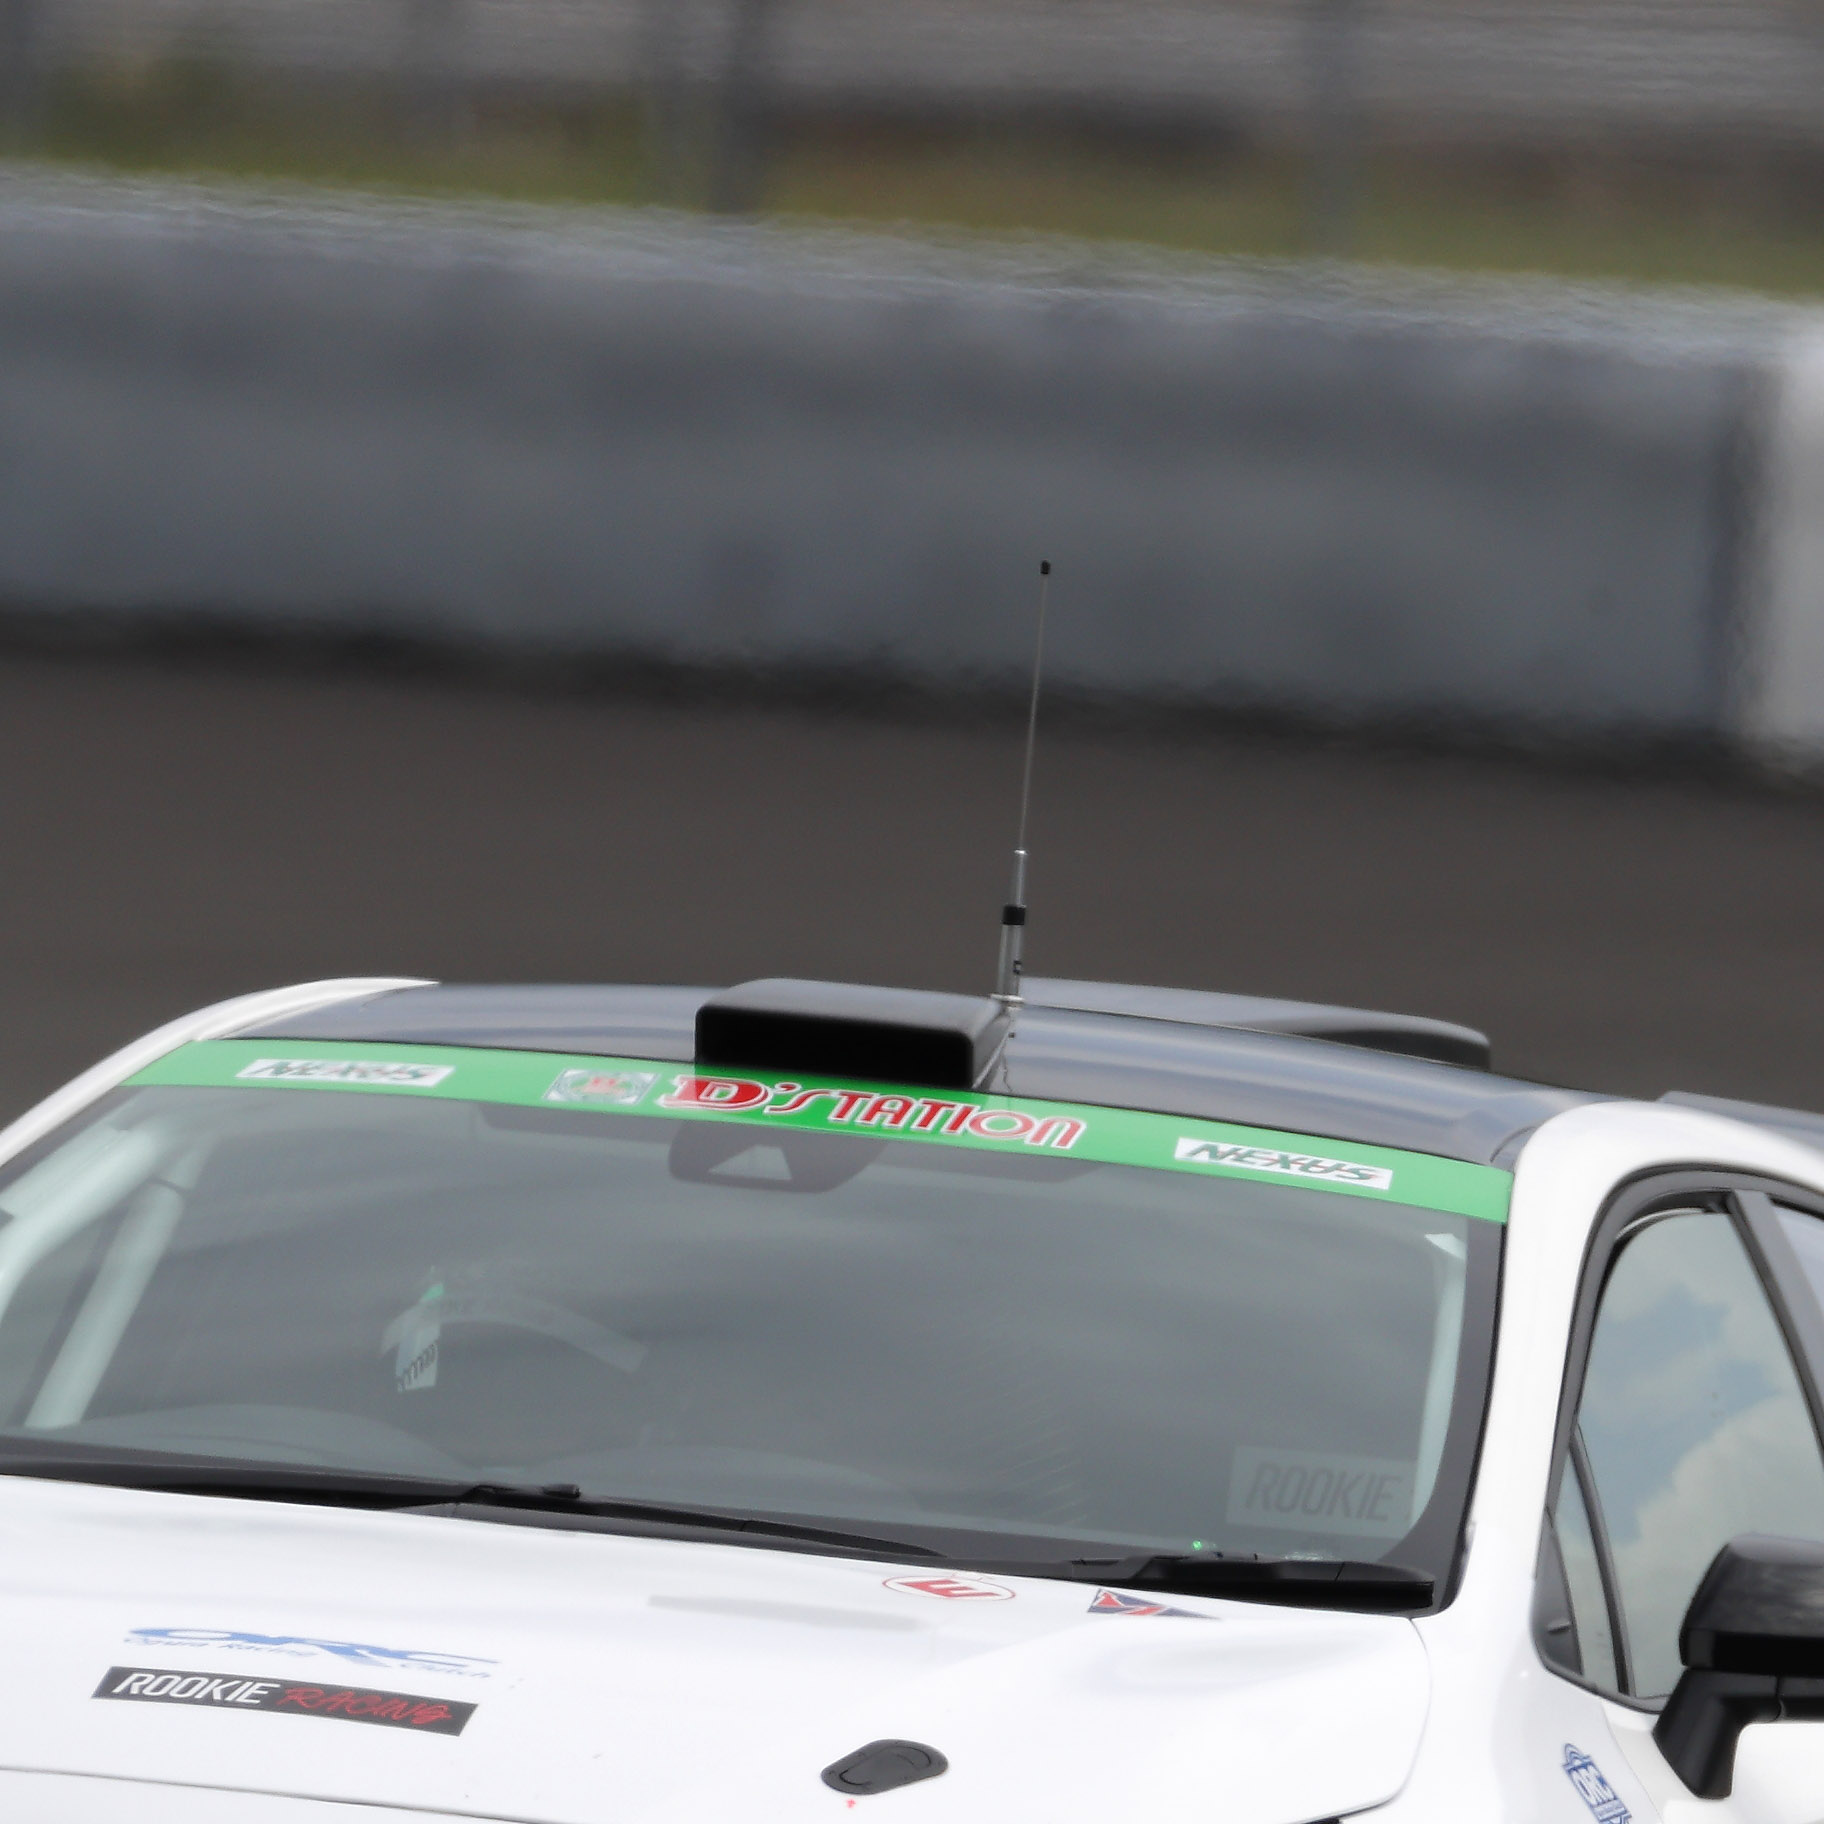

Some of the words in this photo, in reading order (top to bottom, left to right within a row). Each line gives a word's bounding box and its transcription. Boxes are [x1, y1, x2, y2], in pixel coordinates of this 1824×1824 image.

[1188, 1143, 1379, 1182] NEXUS
[1244, 1460, 1404, 1523] ROOKIE
[111, 1672, 280, 1706] ROOKIE
[276, 1687, 453, 1726] RACING
